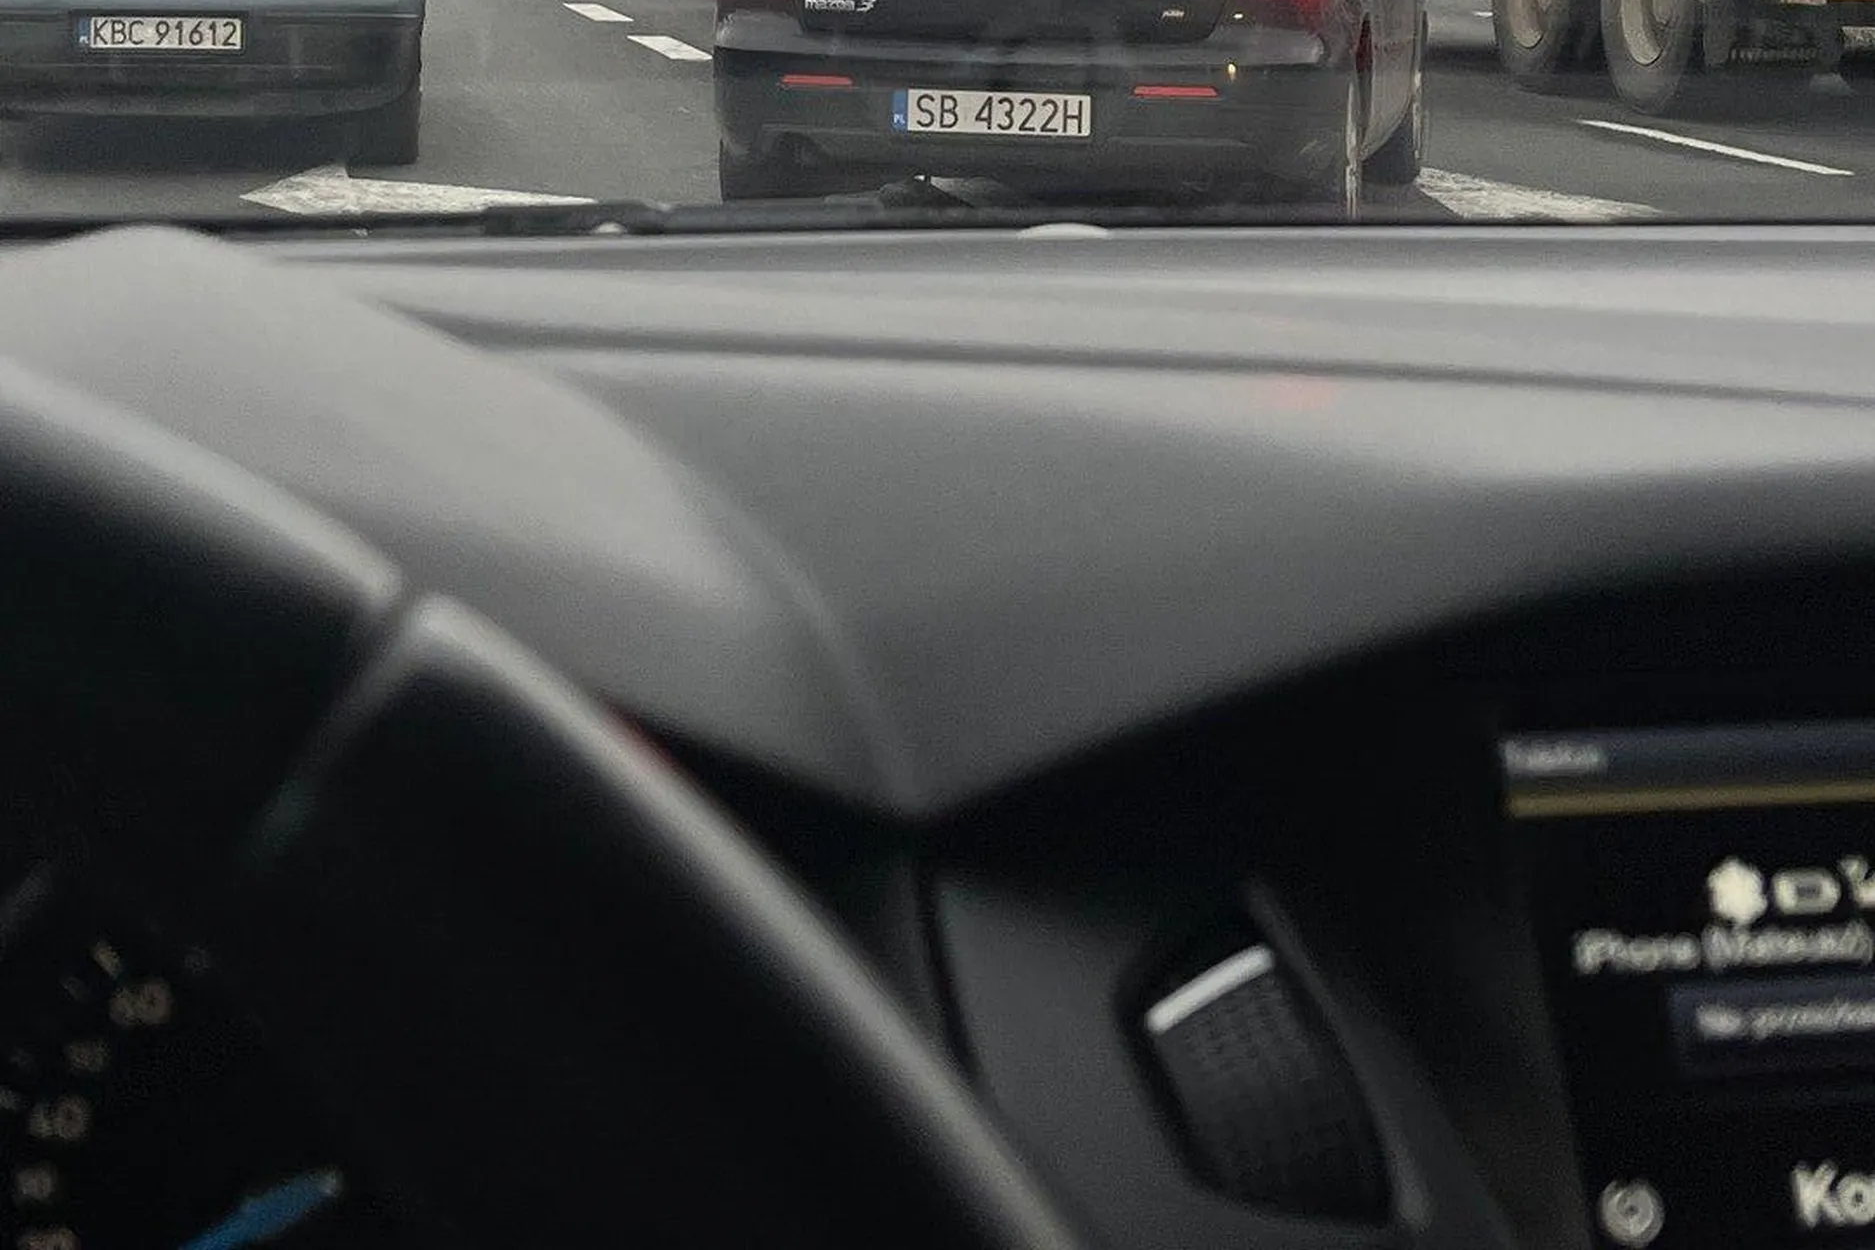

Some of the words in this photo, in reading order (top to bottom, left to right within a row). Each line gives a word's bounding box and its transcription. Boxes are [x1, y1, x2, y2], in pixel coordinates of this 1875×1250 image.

[92, 19, 145, 46] KBC
[155, 20, 238, 47] 91612
[915, 93, 960, 129] SB
[974, 95, 1083, 135] 4322H
